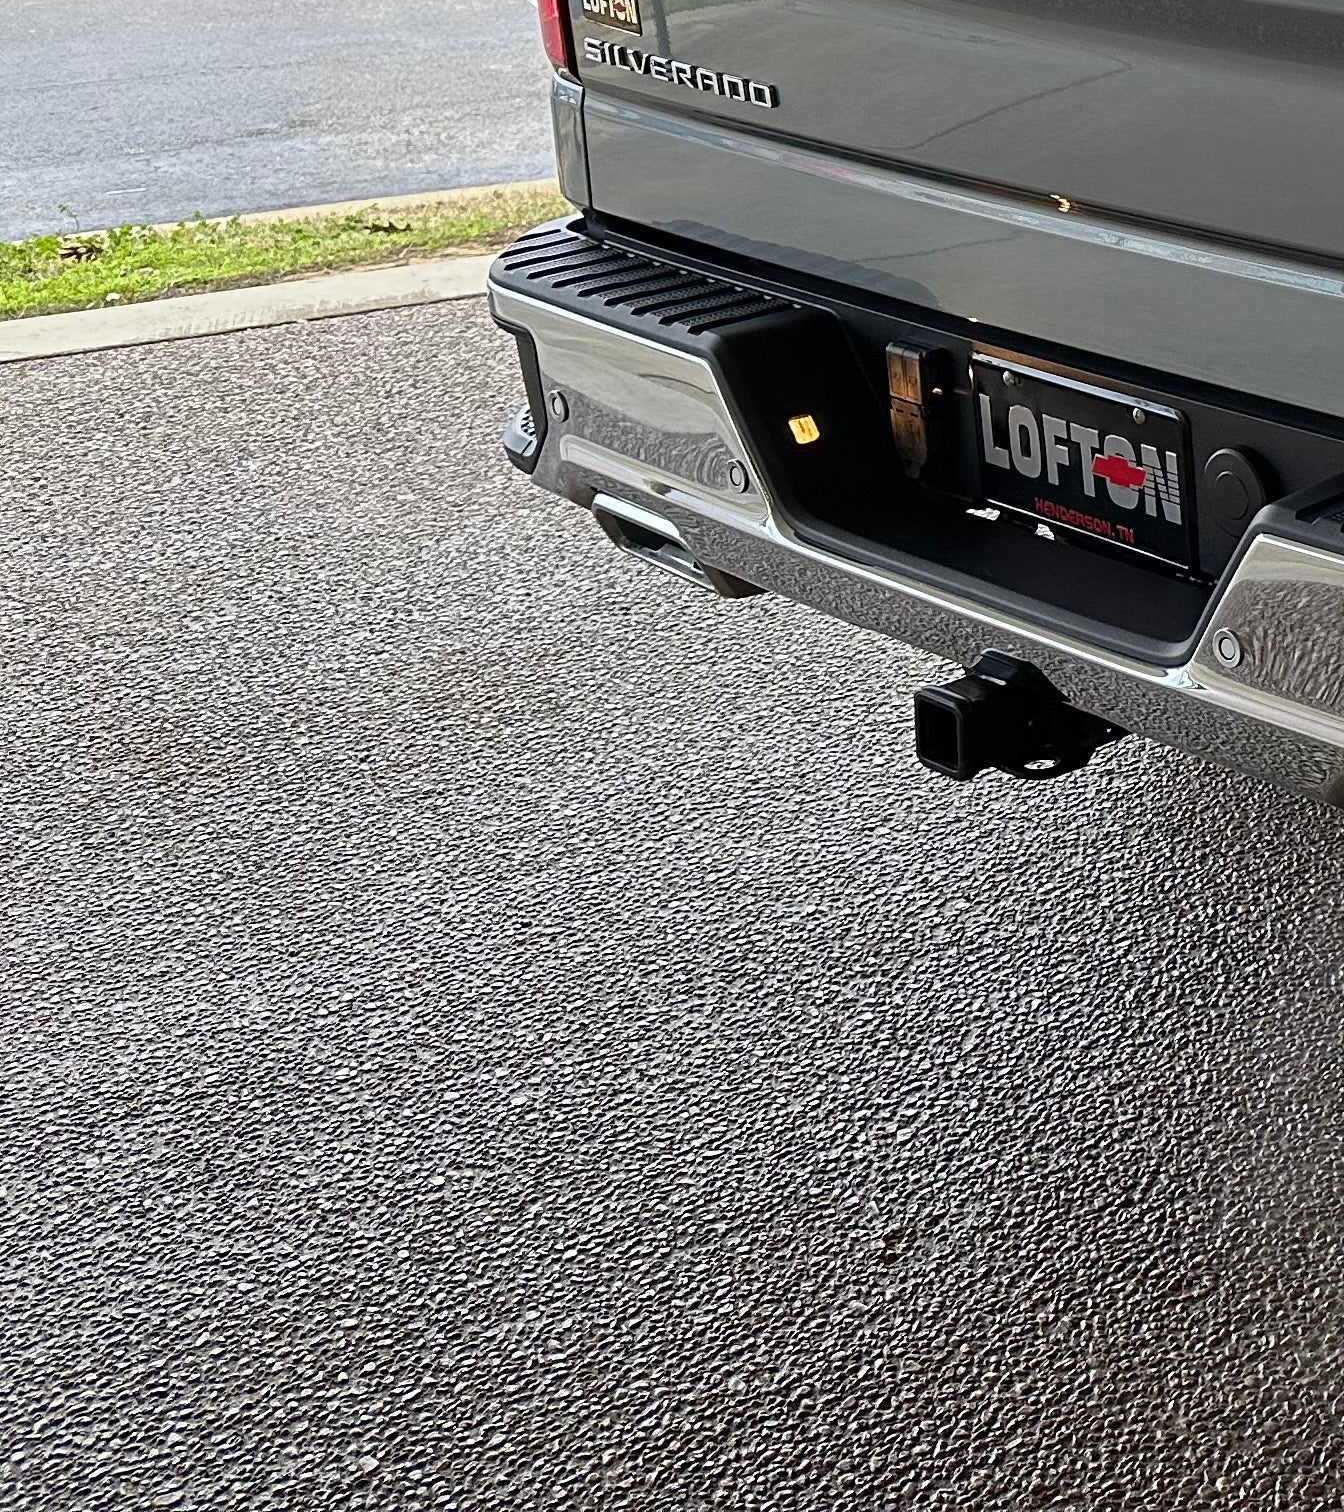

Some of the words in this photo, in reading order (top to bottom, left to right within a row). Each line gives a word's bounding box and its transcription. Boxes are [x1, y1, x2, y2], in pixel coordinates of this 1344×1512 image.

[583, 36, 780, 109] SILVERADO
[978, 392, 1183, 526] LOFTON
[1116, 524, 1135, 545] TN
